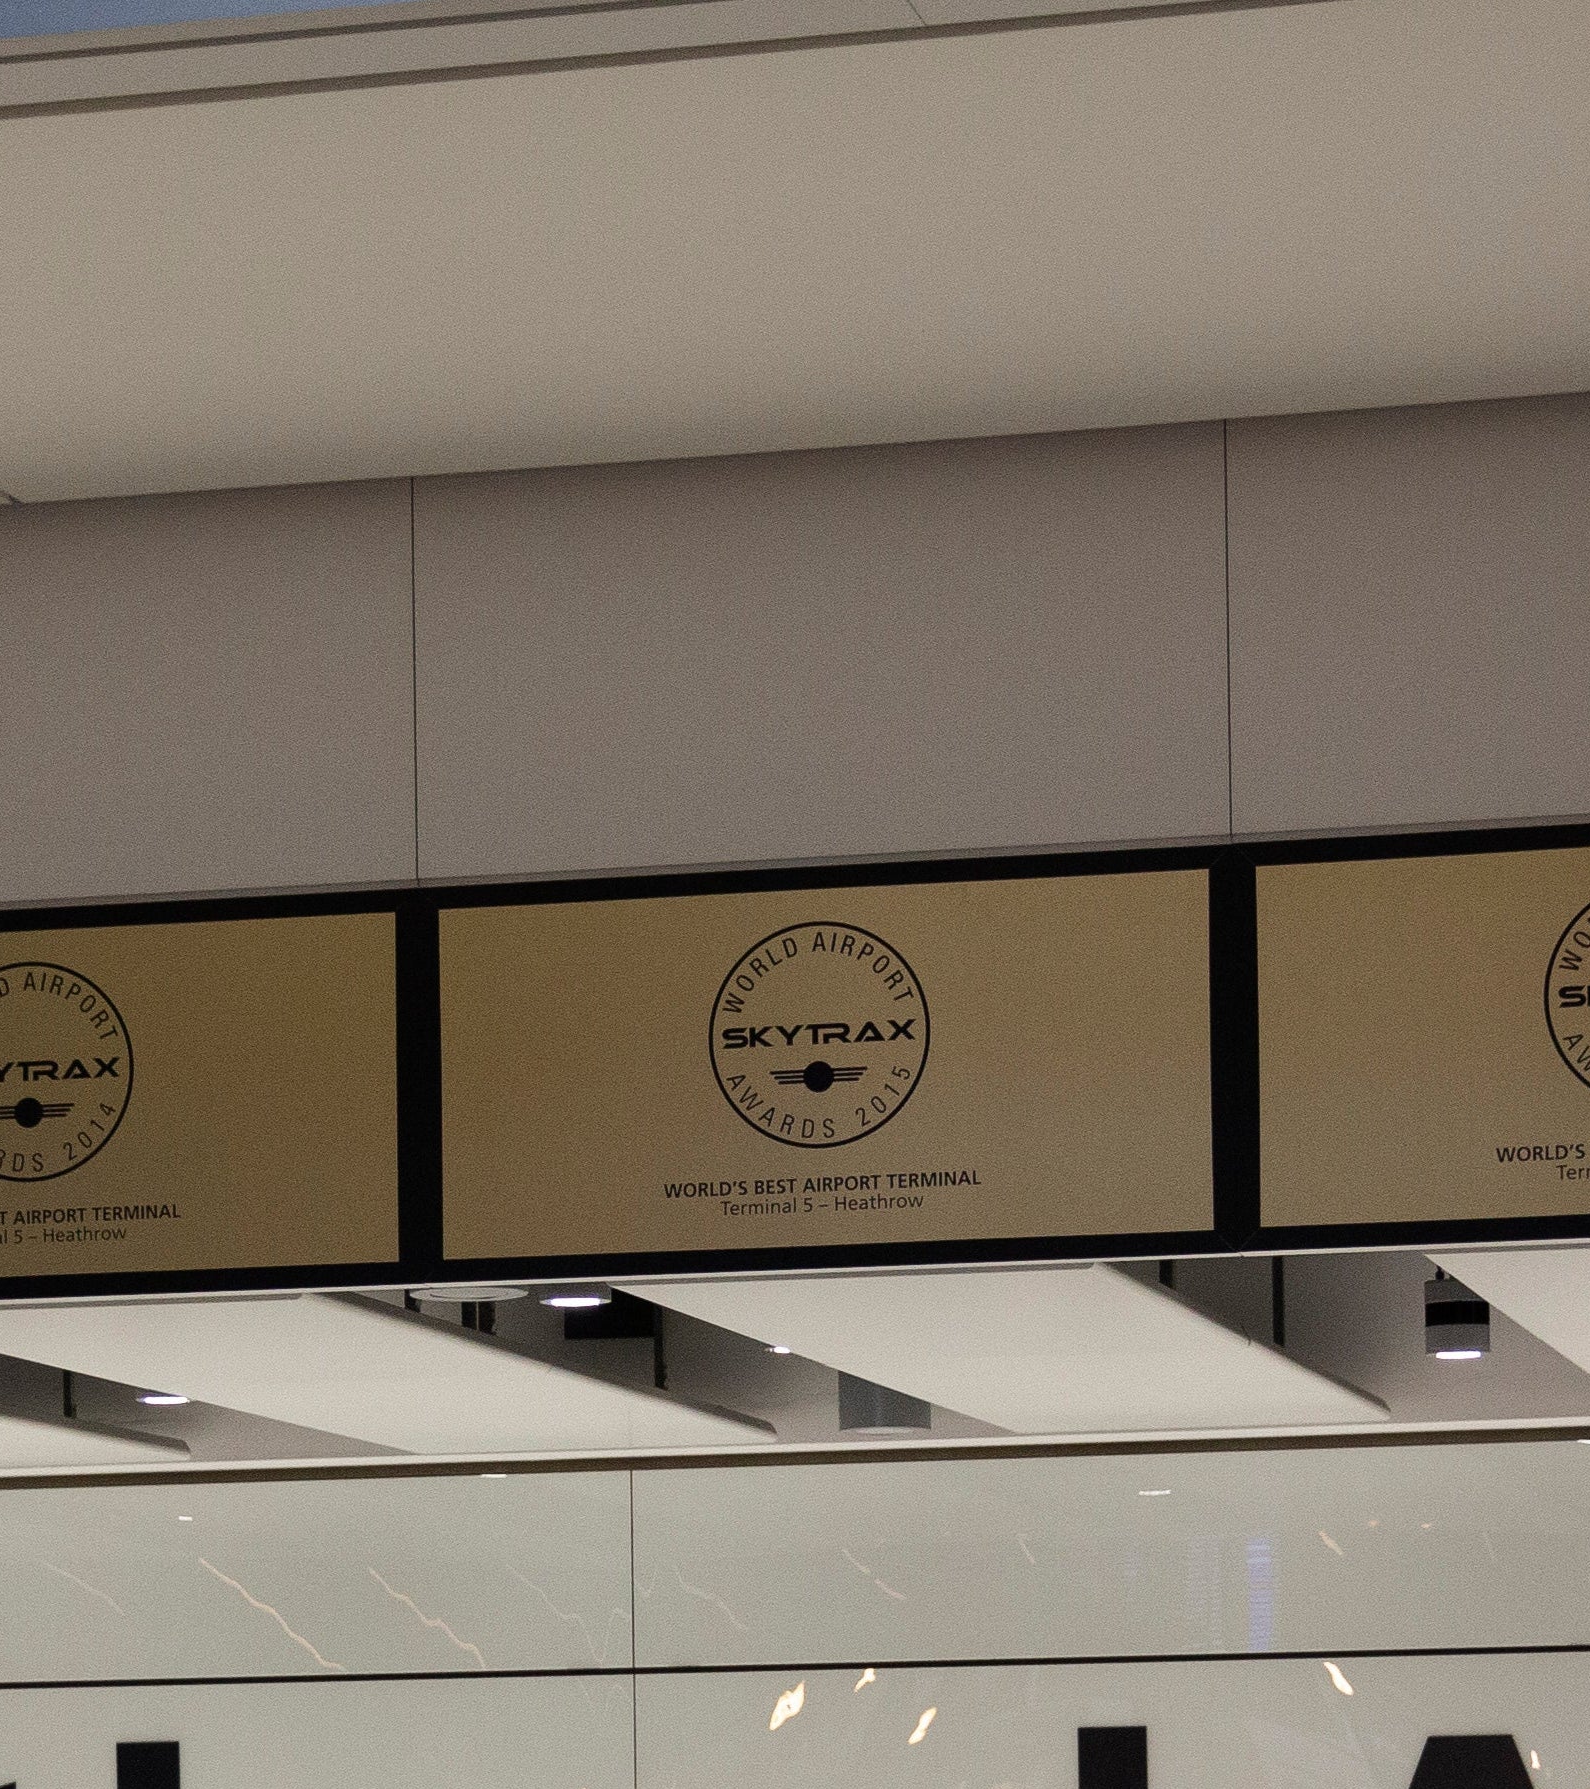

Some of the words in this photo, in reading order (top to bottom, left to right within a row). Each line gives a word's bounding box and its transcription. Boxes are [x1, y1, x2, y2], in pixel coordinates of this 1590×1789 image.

[723, 937, 798, 1015] WORLD
[812, 932, 914, 1001] AIRPORT
[24, 972, 118, 1040] AIRPORT
[722, 1019, 916, 1049] SKYTRAX
[726, 1073, 835, 1139] AWARDS
[855, 1065, 911, 1128] 2015
[63, 1102, 115, 1161] 2014
[1496, 1144, 1585, 1162] WORLD'S
[664, 1181, 747, 1199] WORLD'S
[754, 1179, 797, 1195] BEST
[802, 1175, 881, 1192] AIRPORT
[886, 1170, 981, 1188] TERMINAL
[13, 1208, 85, 1225] AIRPORT
[92, 1204, 181, 1221] TERMINAL
[720, 1198, 796, 1216] Terminal
[803, 1197, 813, 1213] 5
[835, 1193, 923, 1211] Heathrow
[14, 1230, 22, 1244] 5
[43, 1226, 126, 1242] Heathrow
